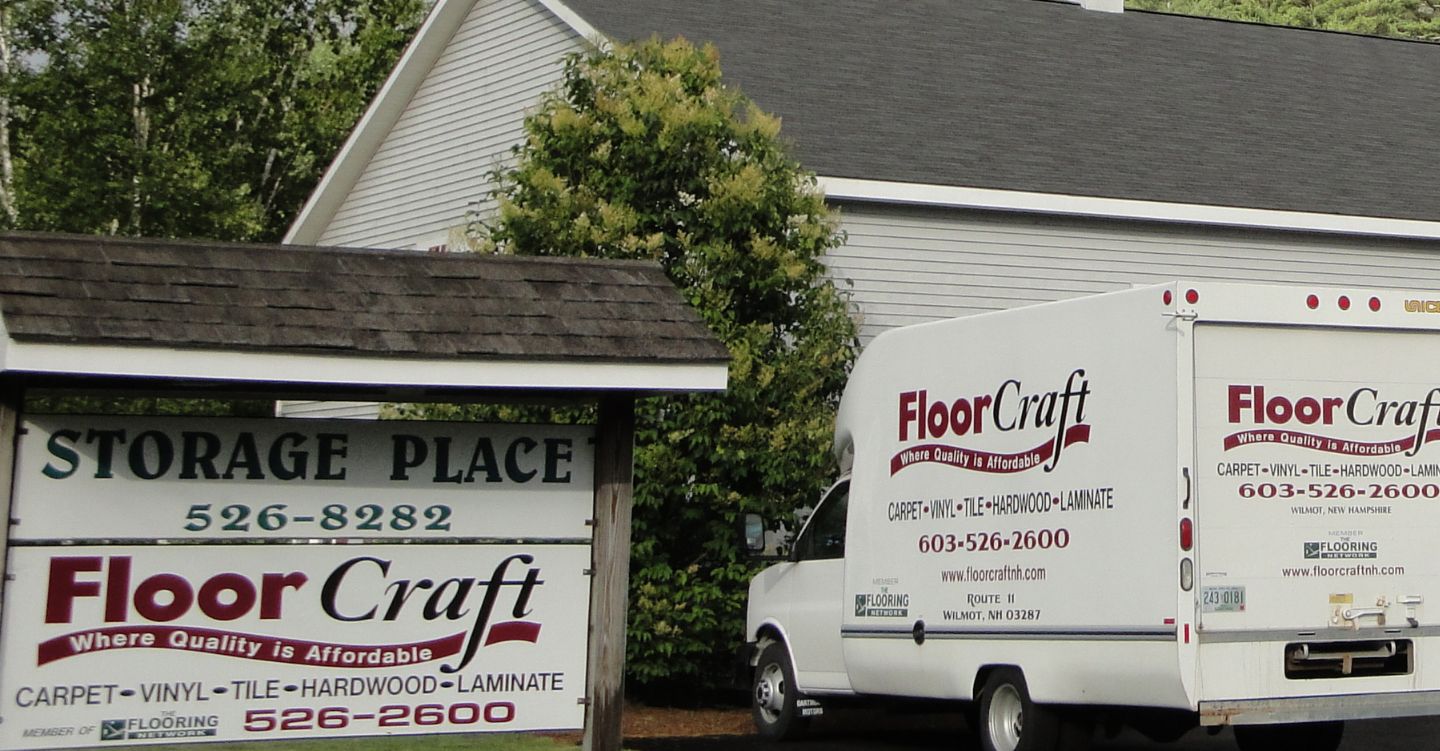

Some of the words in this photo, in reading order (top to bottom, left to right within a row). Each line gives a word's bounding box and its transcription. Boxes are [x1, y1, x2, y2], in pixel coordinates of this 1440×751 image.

[1228, 384, 1344, 424] Floor
[899, 389, 993, 441] Floor
[992, 369, 1091, 473] Craft
[1237, 432, 1274, 444] Where
[1280, 432, 1323, 450] Quality
[1327, 439, 1338, 450] is
[1342, 441, 1402, 455] Affordable
[41, 428, 348, 481] STORAGE
[389, 433, 573, 484] PLACE
[900, 449, 930, 466] Where
[934, 447, 970, 467] Quality
[973, 453, 983, 467] is
[986, 452, 1041, 470] Affordable
[1217, 462, 1261, 477] CARPET
[1269, 463, 1301, 477] VINYL
[1309, 463, 1332, 478] TILE
[1340, 464, 1402, 478] HARDWOOD
[1238, 482, 1440, 499] 603-526-2600
[888, 501, 924, 522] CARPET
[929, 498, 956, 519] VINYL
[963, 496, 984, 517] TILE
[992, 491, 1051, 516] HARDWOOD
[1060, 487, 1114, 512] LAMINATE
[1291, 506, 1326, 515] WILMOT,
[1328, 506, 1345, 514] NEW
[1348, 506, 1392, 514] HAMPSHIRE
[183, 503, 453, 532] 526-8282
[918, 528, 1070, 553] 603-526-2600
[1320, 541, 1378, 551] FLOORING
[941, 564, 1046, 582] www.floorcraftnh.com
[1282, 564, 1405, 577] www.floorcraftnh.com
[866, 593, 909, 607] FLOORING
[1203, 591, 1220, 604] 243
[44, 555, 309, 624] Floor
[320, 553, 545, 674] Craft
[988, 609, 1003, 620] NH
[1005, 609, 1041, 621] 03287
[70, 629, 155, 652] Where
[168, 630, 262, 657] Quality
[273, 640, 295, 660] is
[305, 644, 433, 665] Affordable
[16, 684, 119, 708] CARPET
[140, 681, 209, 703] VINYL
[231, 679, 281, 700] TILE
[301, 674, 438, 698] HARDWOOD
[457, 672, 565, 693] LAMINATE
[128, 715, 219, 730] FLOORING
[243, 701, 516, 732] 526-2600
[22, 727, 74, 739] MEMBER
[79, 726, 97, 736] OF
[136, 730, 208, 739] NETWORK
